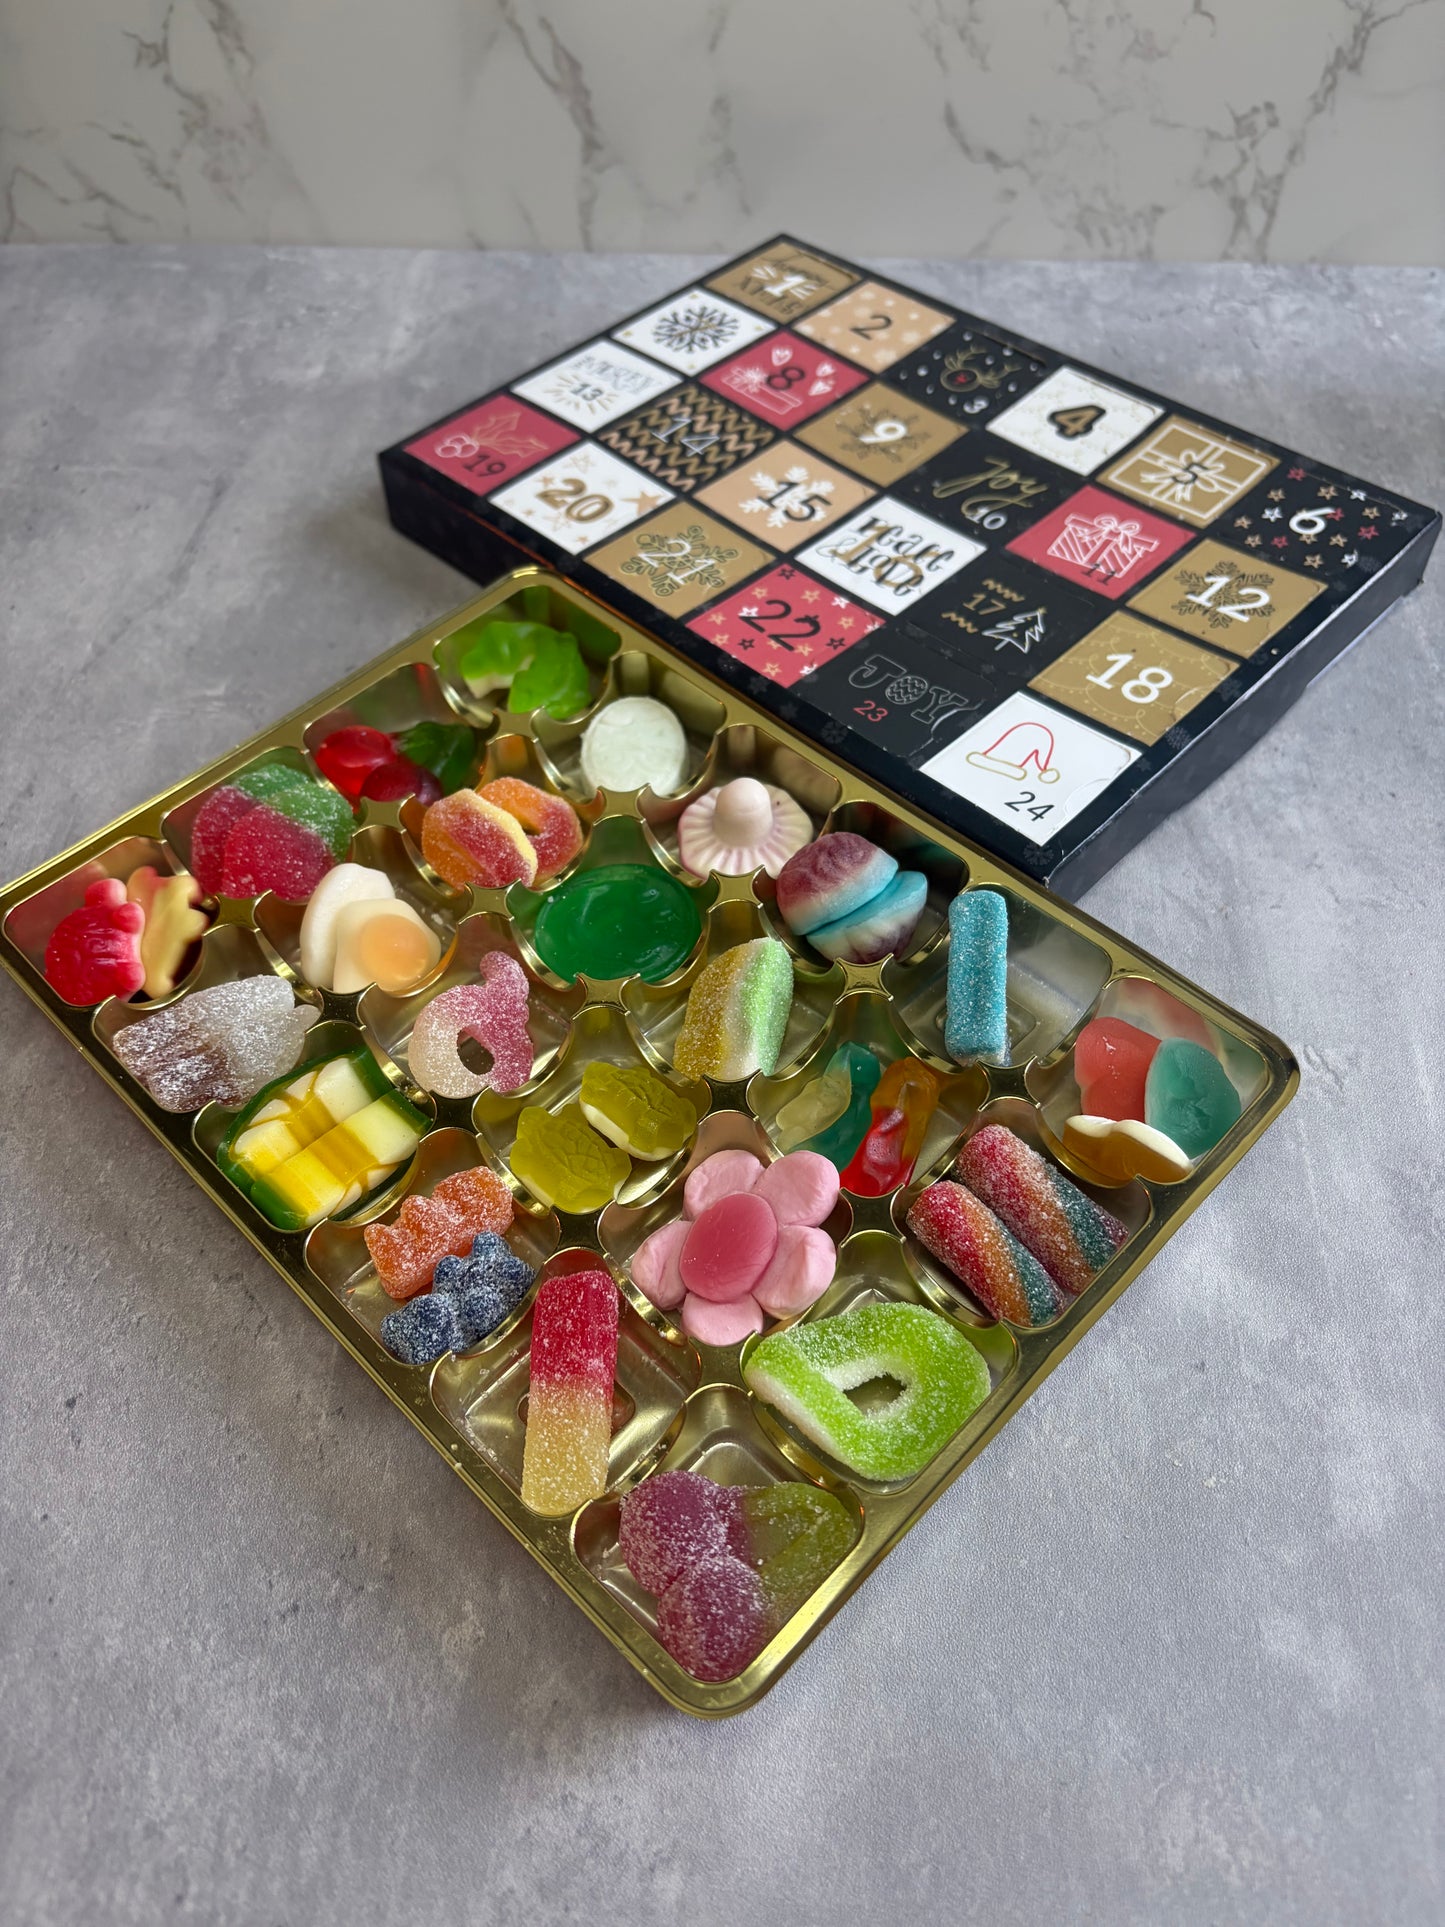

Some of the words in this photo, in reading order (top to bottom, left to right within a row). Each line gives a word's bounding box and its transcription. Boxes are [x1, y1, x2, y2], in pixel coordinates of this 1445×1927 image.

[764, 275, 807, 298] 1
[850, 314, 893, 340] 2
[766, 366, 806, 391] 8
[571, 383, 603, 401] 13
[963, 398, 989, 414] 3
[859, 420, 907, 444] 9
[1048, 405, 1106, 440] 4
[650, 418, 721, 457] 14
[462, 454, 507, 477] 19
[1171, 463, 1209, 485] 5
[534, 478, 614, 524] 20
[756, 481, 832, 521] 15
[965, 505, 1007, 530] 10
[1289, 507, 1337, 536] 6
[637, 538, 716, 585] 21
[1081, 564, 1117, 585] 11
[962, 592, 1006, 616] 17
[1186, 575, 1271, 622] 12
[738, 599, 821, 652] 22
[848, 653, 970, 725] JOY
[1085, 652, 1174, 705] 18
[853, 699, 889, 723] 23
[1004, 791, 1056, 822] 24
